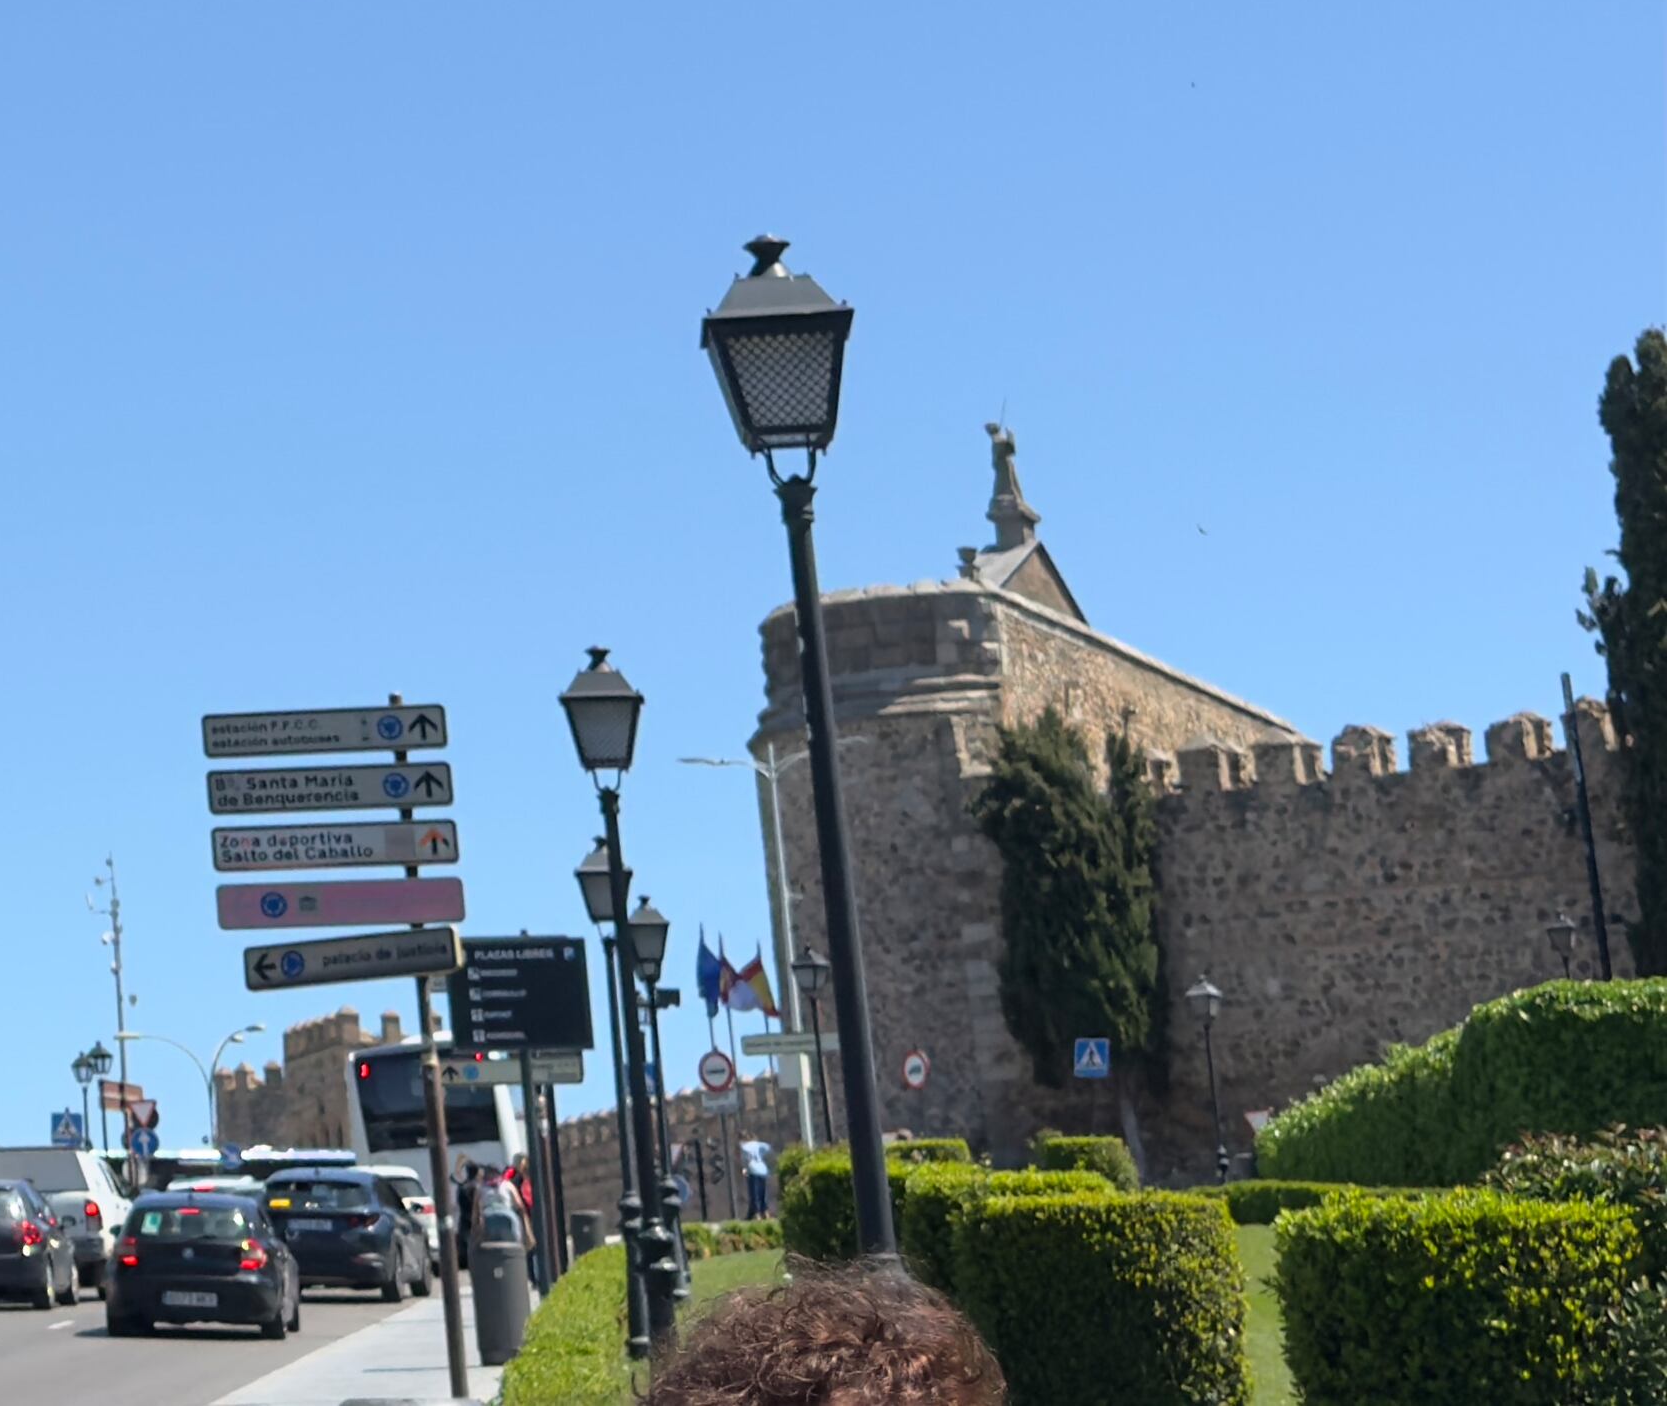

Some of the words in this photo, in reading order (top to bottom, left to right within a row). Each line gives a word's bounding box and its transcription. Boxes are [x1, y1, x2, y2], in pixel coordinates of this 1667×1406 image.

[212, 721, 267, 735] estación
[246, 776, 298, 790] Santa
[218, 794, 238, 806] de
[244, 790, 359, 808] Benquerencia
[220, 835, 261, 848] Zona
[267, 831, 353, 847] deportiva
[222, 849, 267, 863] Salto
[273, 847, 299, 861] del
[305, 845, 373, 860] Caballo
